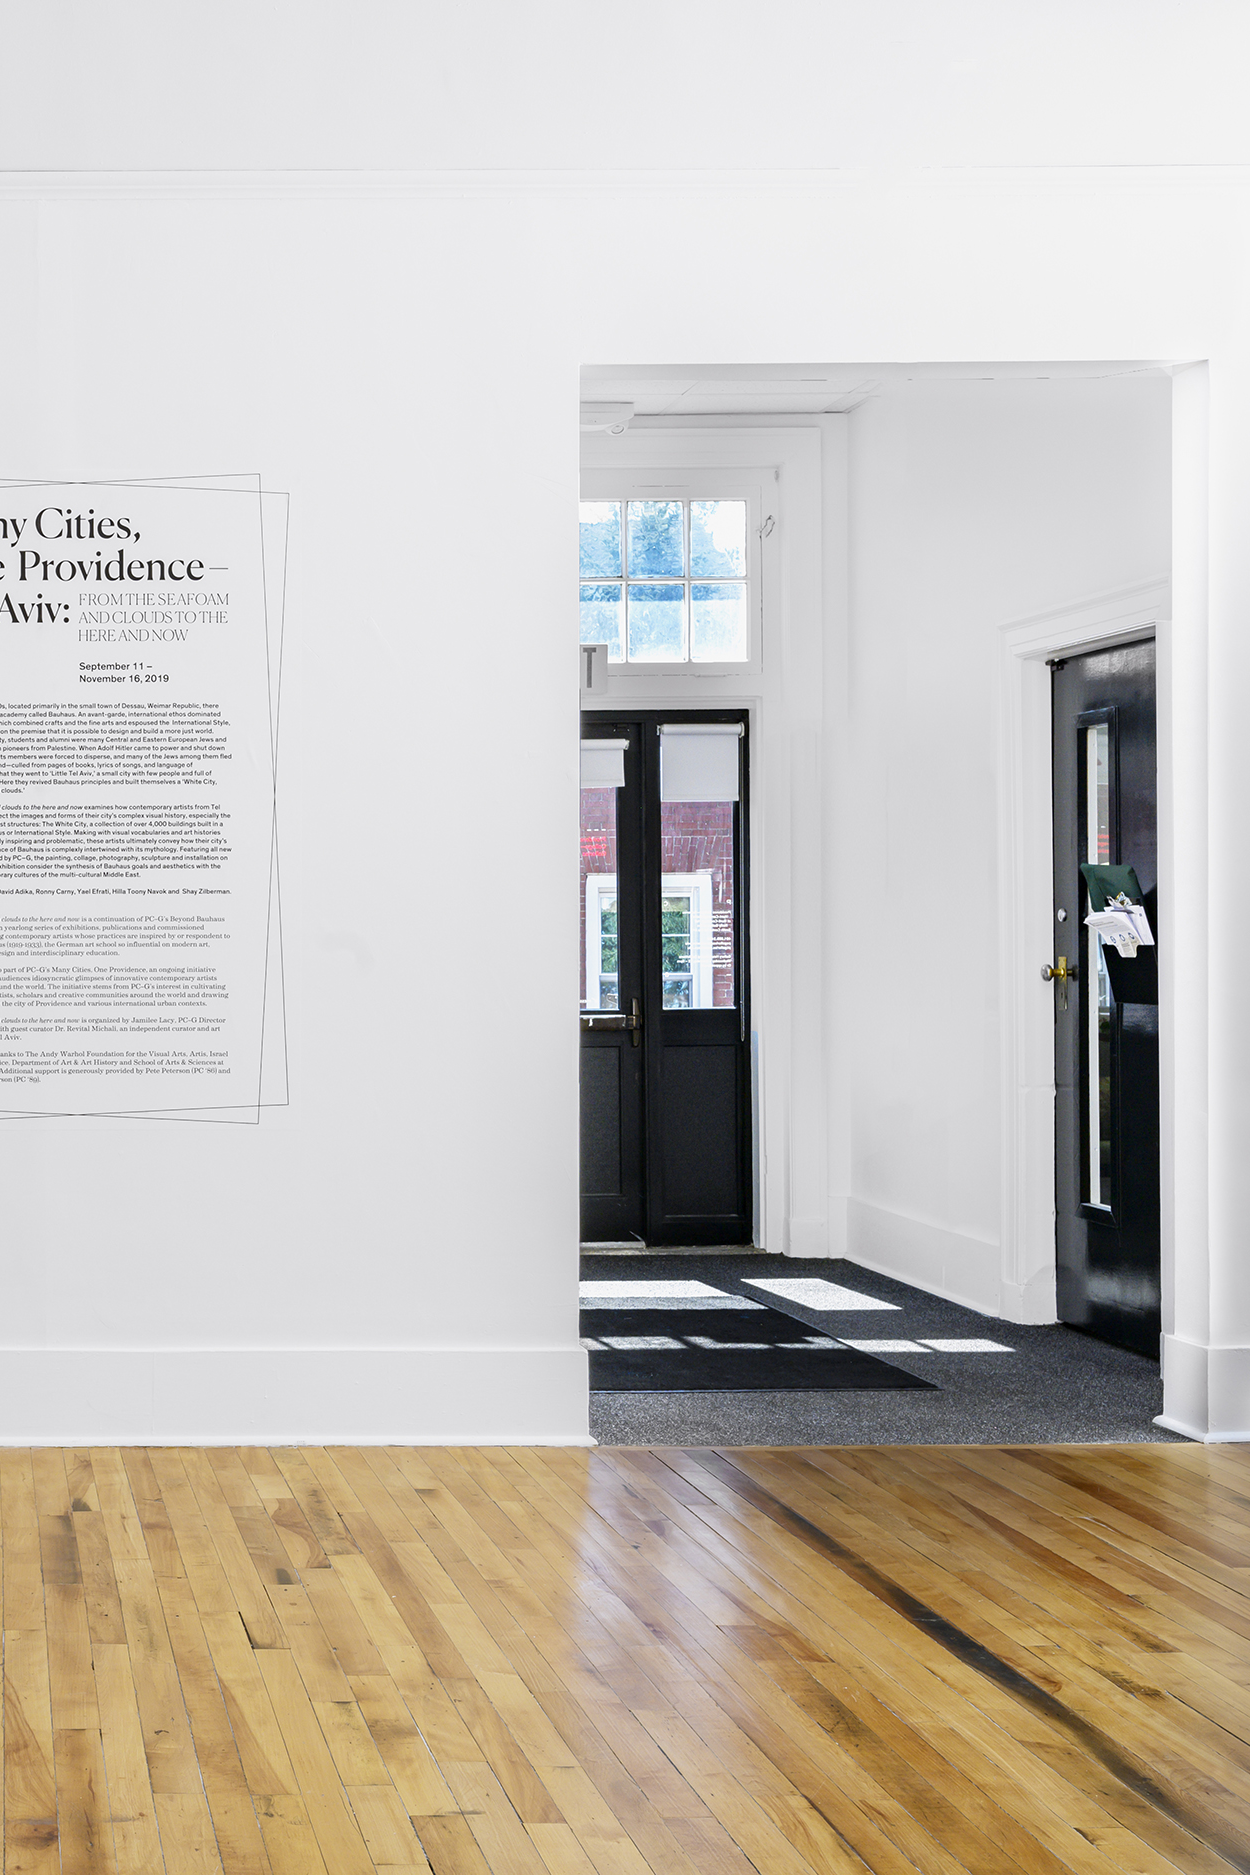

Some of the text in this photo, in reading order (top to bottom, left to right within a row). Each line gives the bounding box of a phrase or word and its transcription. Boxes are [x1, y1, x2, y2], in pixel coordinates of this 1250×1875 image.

[35, 507, 140, 544] Cities,
[79, 593, 229, 606] FROM THE SEAFOAM
[79, 611, 228, 624] AND CLOUDS TO THE
[79, 629, 188, 642] HERE AND NOW
[79, 662, 130, 672] September
[133, 662, 143, 670] 11
[80, 674, 169, 684] November 16, 2019
[32, 703, 60, 711] primarily
[0, 711, 28, 719] academy
[87, 737, 105, 745] many
[167, 736, 198, 744] European
[5, 838, 33, 846] inspiring
[126, 838, 157, 846] ultimately
[158, 838, 180, 846] convey
[35, 888, 55, 896] Ronny
[127, 888, 146, 896] Toony
[182, 888, 198, 896] Shay
[4, 924, 34, 932] yearlong
[102, 924, 143, 932] publications
[31, 975, 74, 983] idiosyncratic
[74, 975, 105, 983] glimpses
[149, 975, 195, 983] contemporary
[200, 991, 229, 1000] drawing
[13, 1000, 26, 1008] city
[10, 1025, 28, 1034] guest
[129, 1025, 171, 1034] independent
